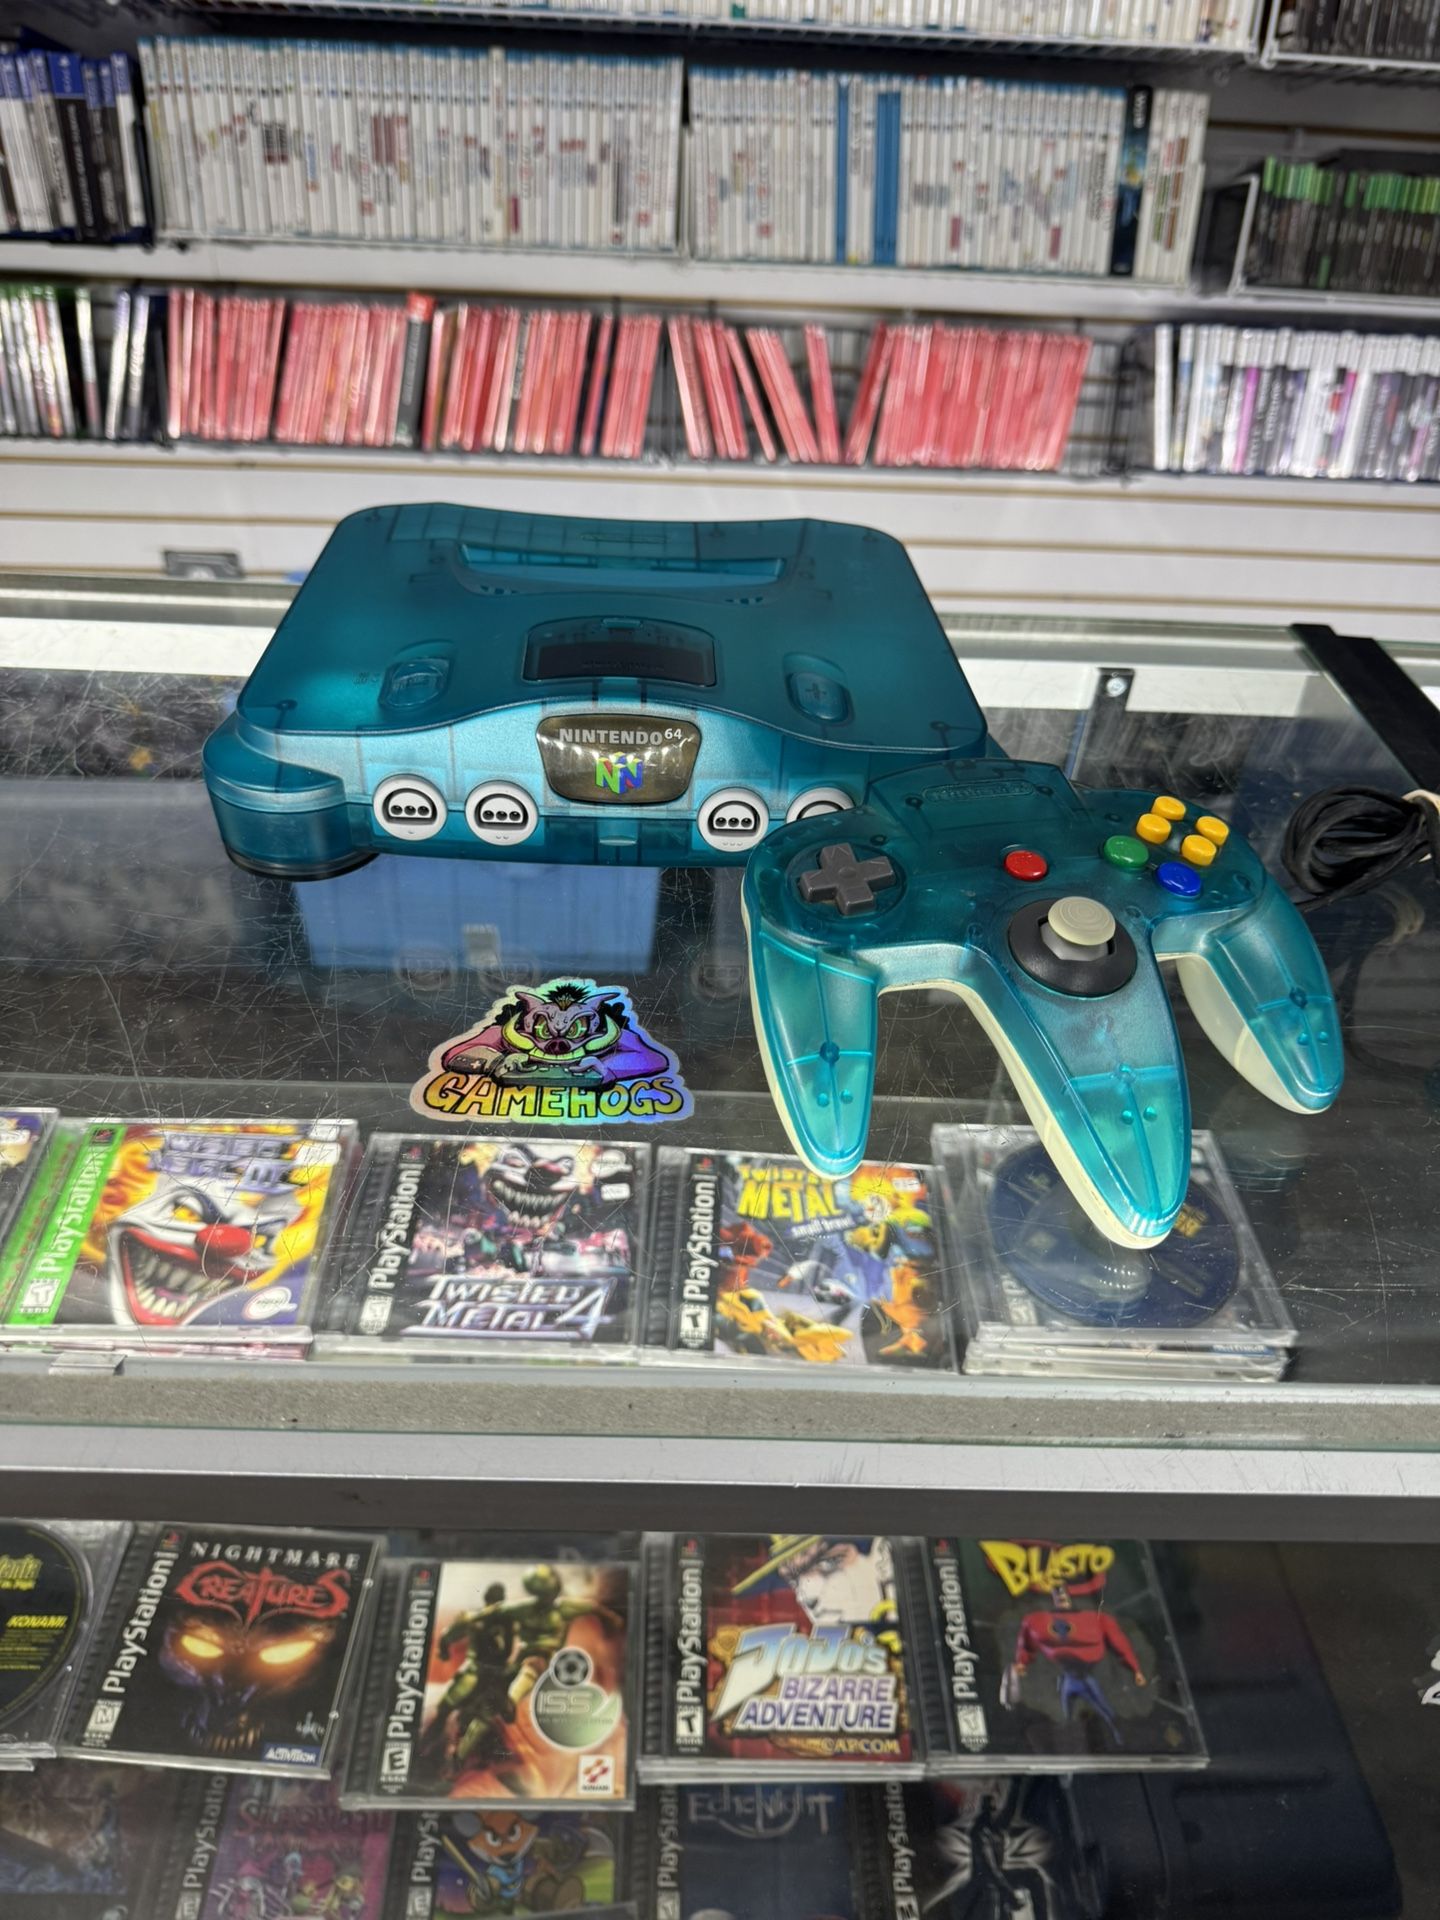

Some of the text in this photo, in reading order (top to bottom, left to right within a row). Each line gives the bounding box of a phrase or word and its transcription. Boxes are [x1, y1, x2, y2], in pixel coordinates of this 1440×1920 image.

[558, 728, 683, 746] NINTENDO 64
[422, 1071, 685, 1120] GAMEHOGS
[36, 1152, 105, 1273] PlayStation
[737, 1178, 842, 1224] METAL
[367, 1169, 423, 1290] PlayStation
[683, 1180, 719, 1300] PlayStation
[190, 1541, 361, 1571] NIGHTMARE
[6, 1614, 68, 1629] KONAMI
[102, 1560, 177, 1693] PlayStation
[676, 1567, 708, 1703] PlayStation
[938, 1565, 980, 1699] PlayStation
[387, 1598, 431, 1739] PlayStation
[783, 1676, 894, 1702] BIZARRE
[740, 1701, 896, 1730] ADVENTURE
[821, 1737, 901, 1755] CAPCOM
